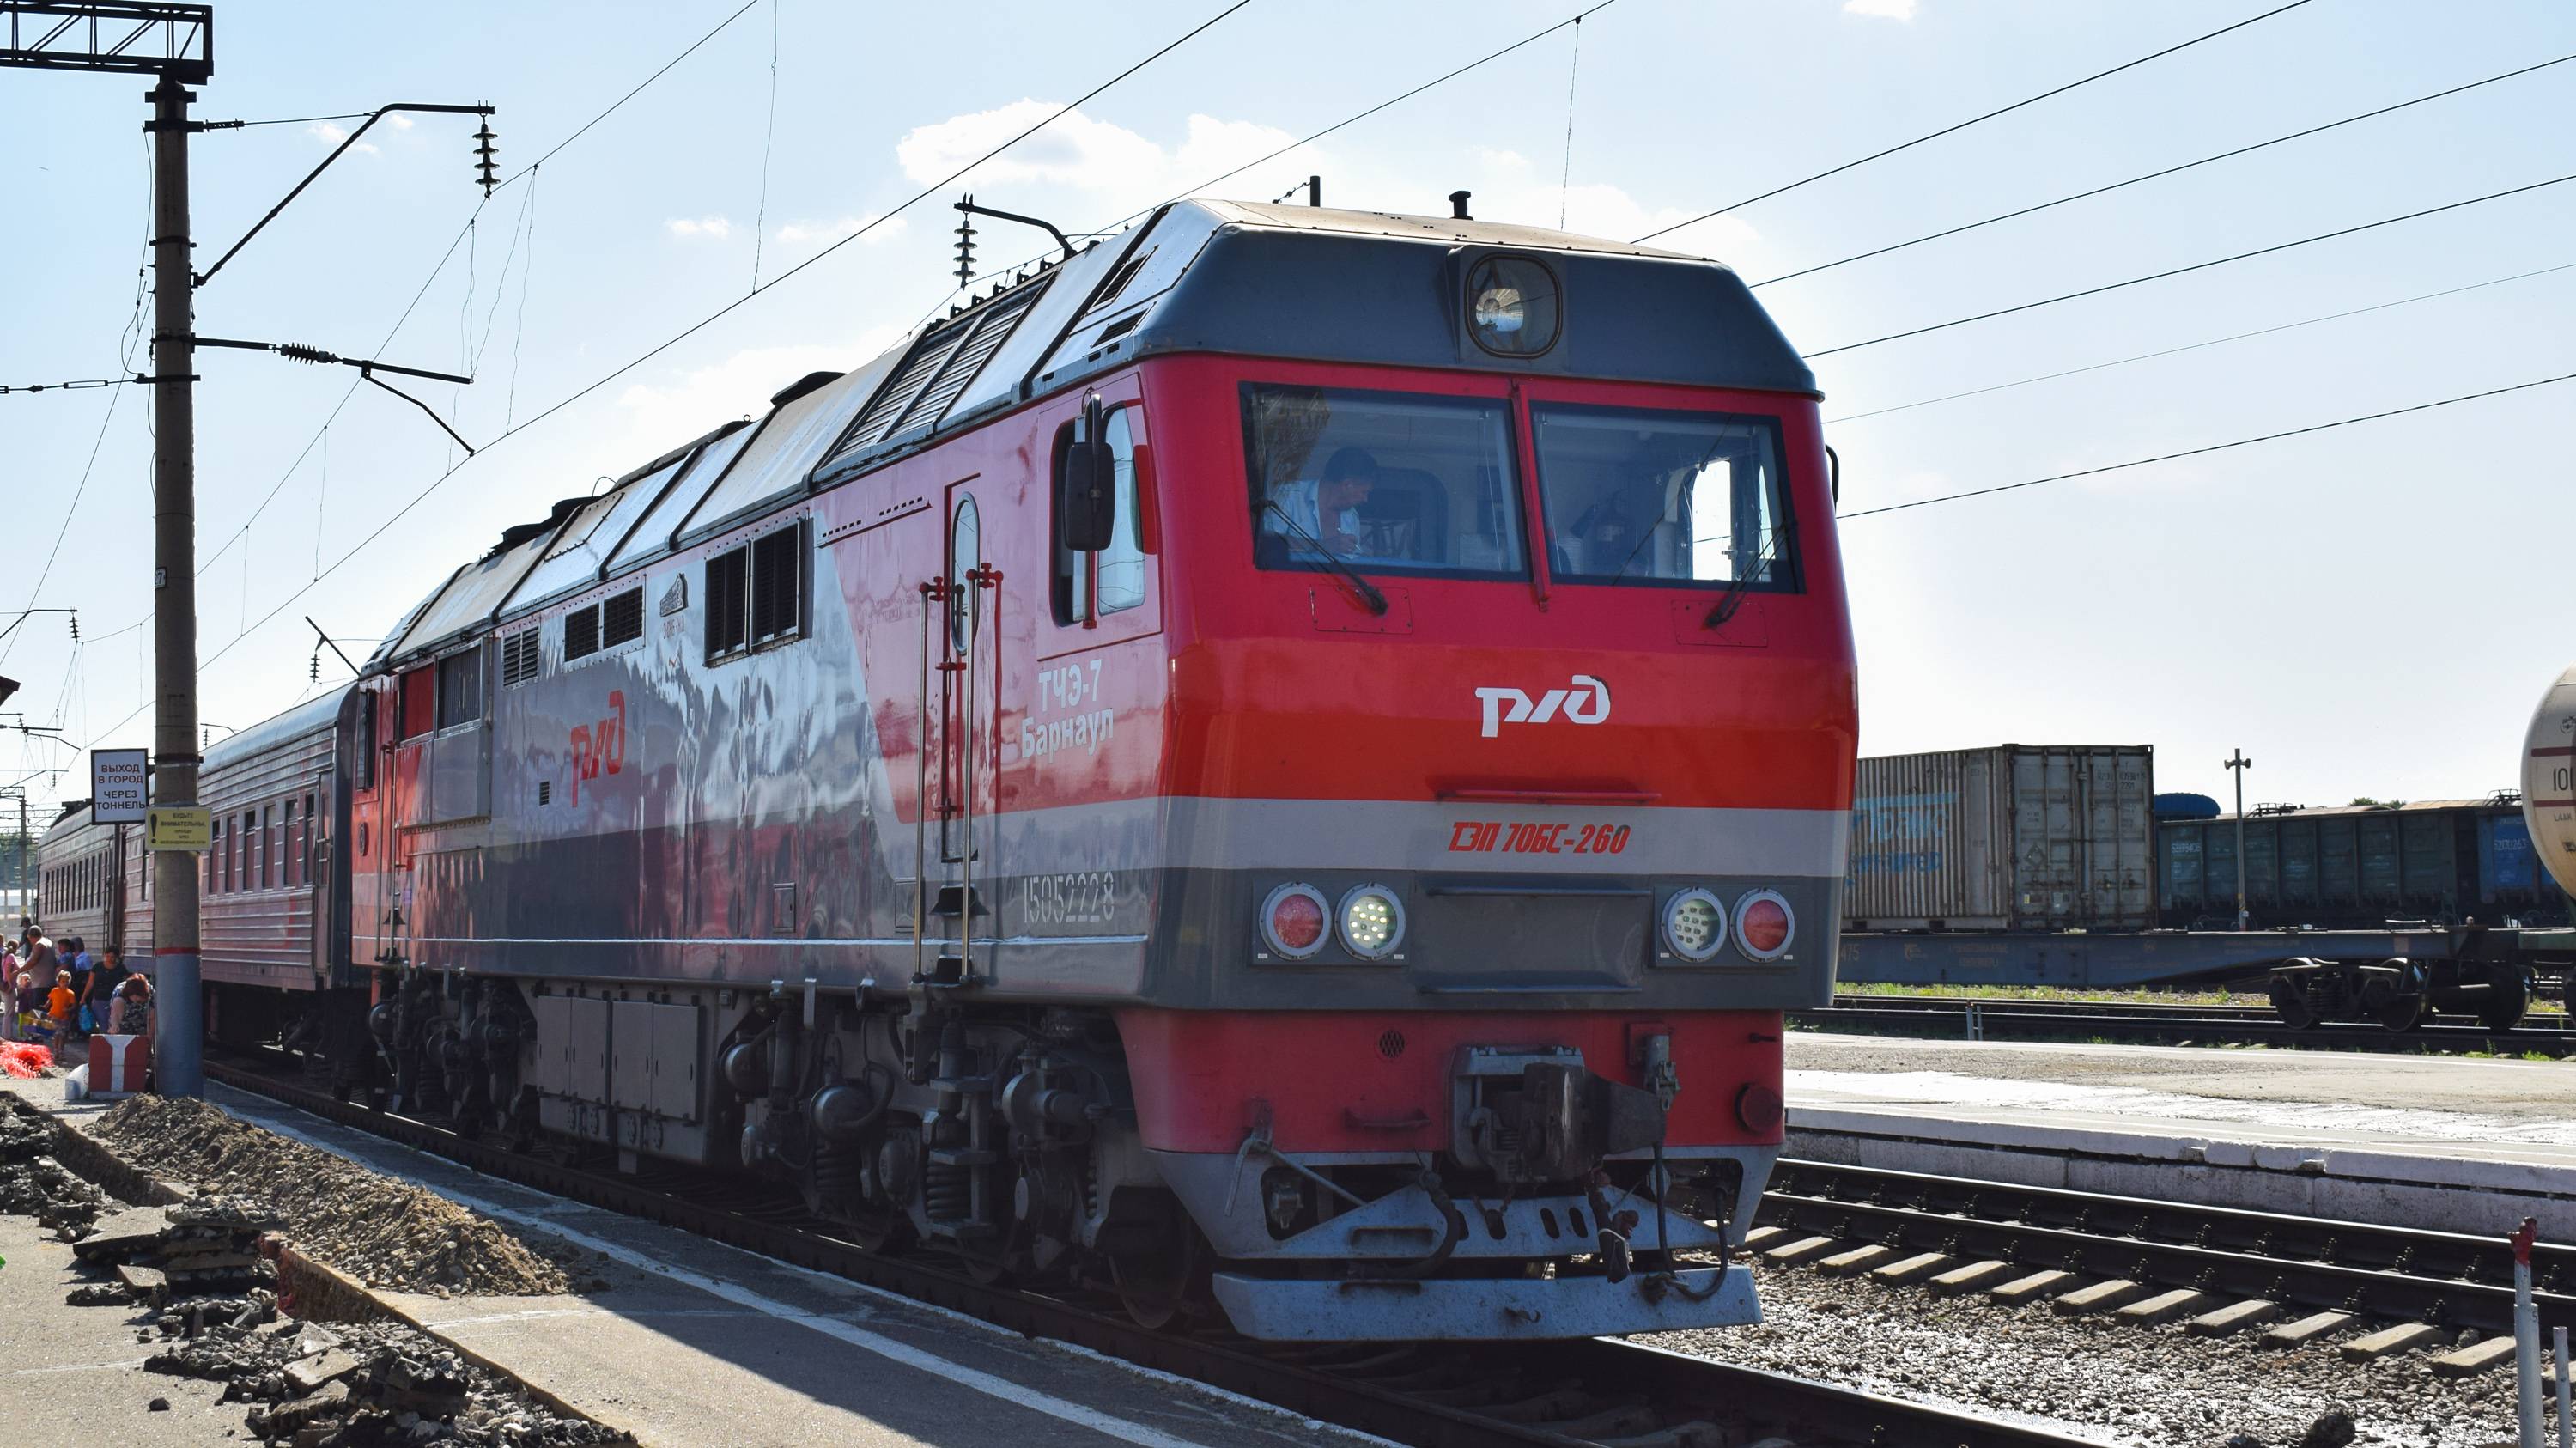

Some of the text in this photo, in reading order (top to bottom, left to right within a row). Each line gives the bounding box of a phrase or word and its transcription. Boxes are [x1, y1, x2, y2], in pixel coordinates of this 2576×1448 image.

[1038, 659, 1102, 712] ТЧЭ-7
[1022, 709, 1115, 764] Барнаул
[101, 764, 140, 774] ВЫХОД
[109, 776, 143, 785] ГОРОД
[104, 790, 137, 799] ЧЕРЕЗ
[97, 801, 146, 810] ТОННЕЛЬ
[1024, 871, 1115, 924] 15052228
